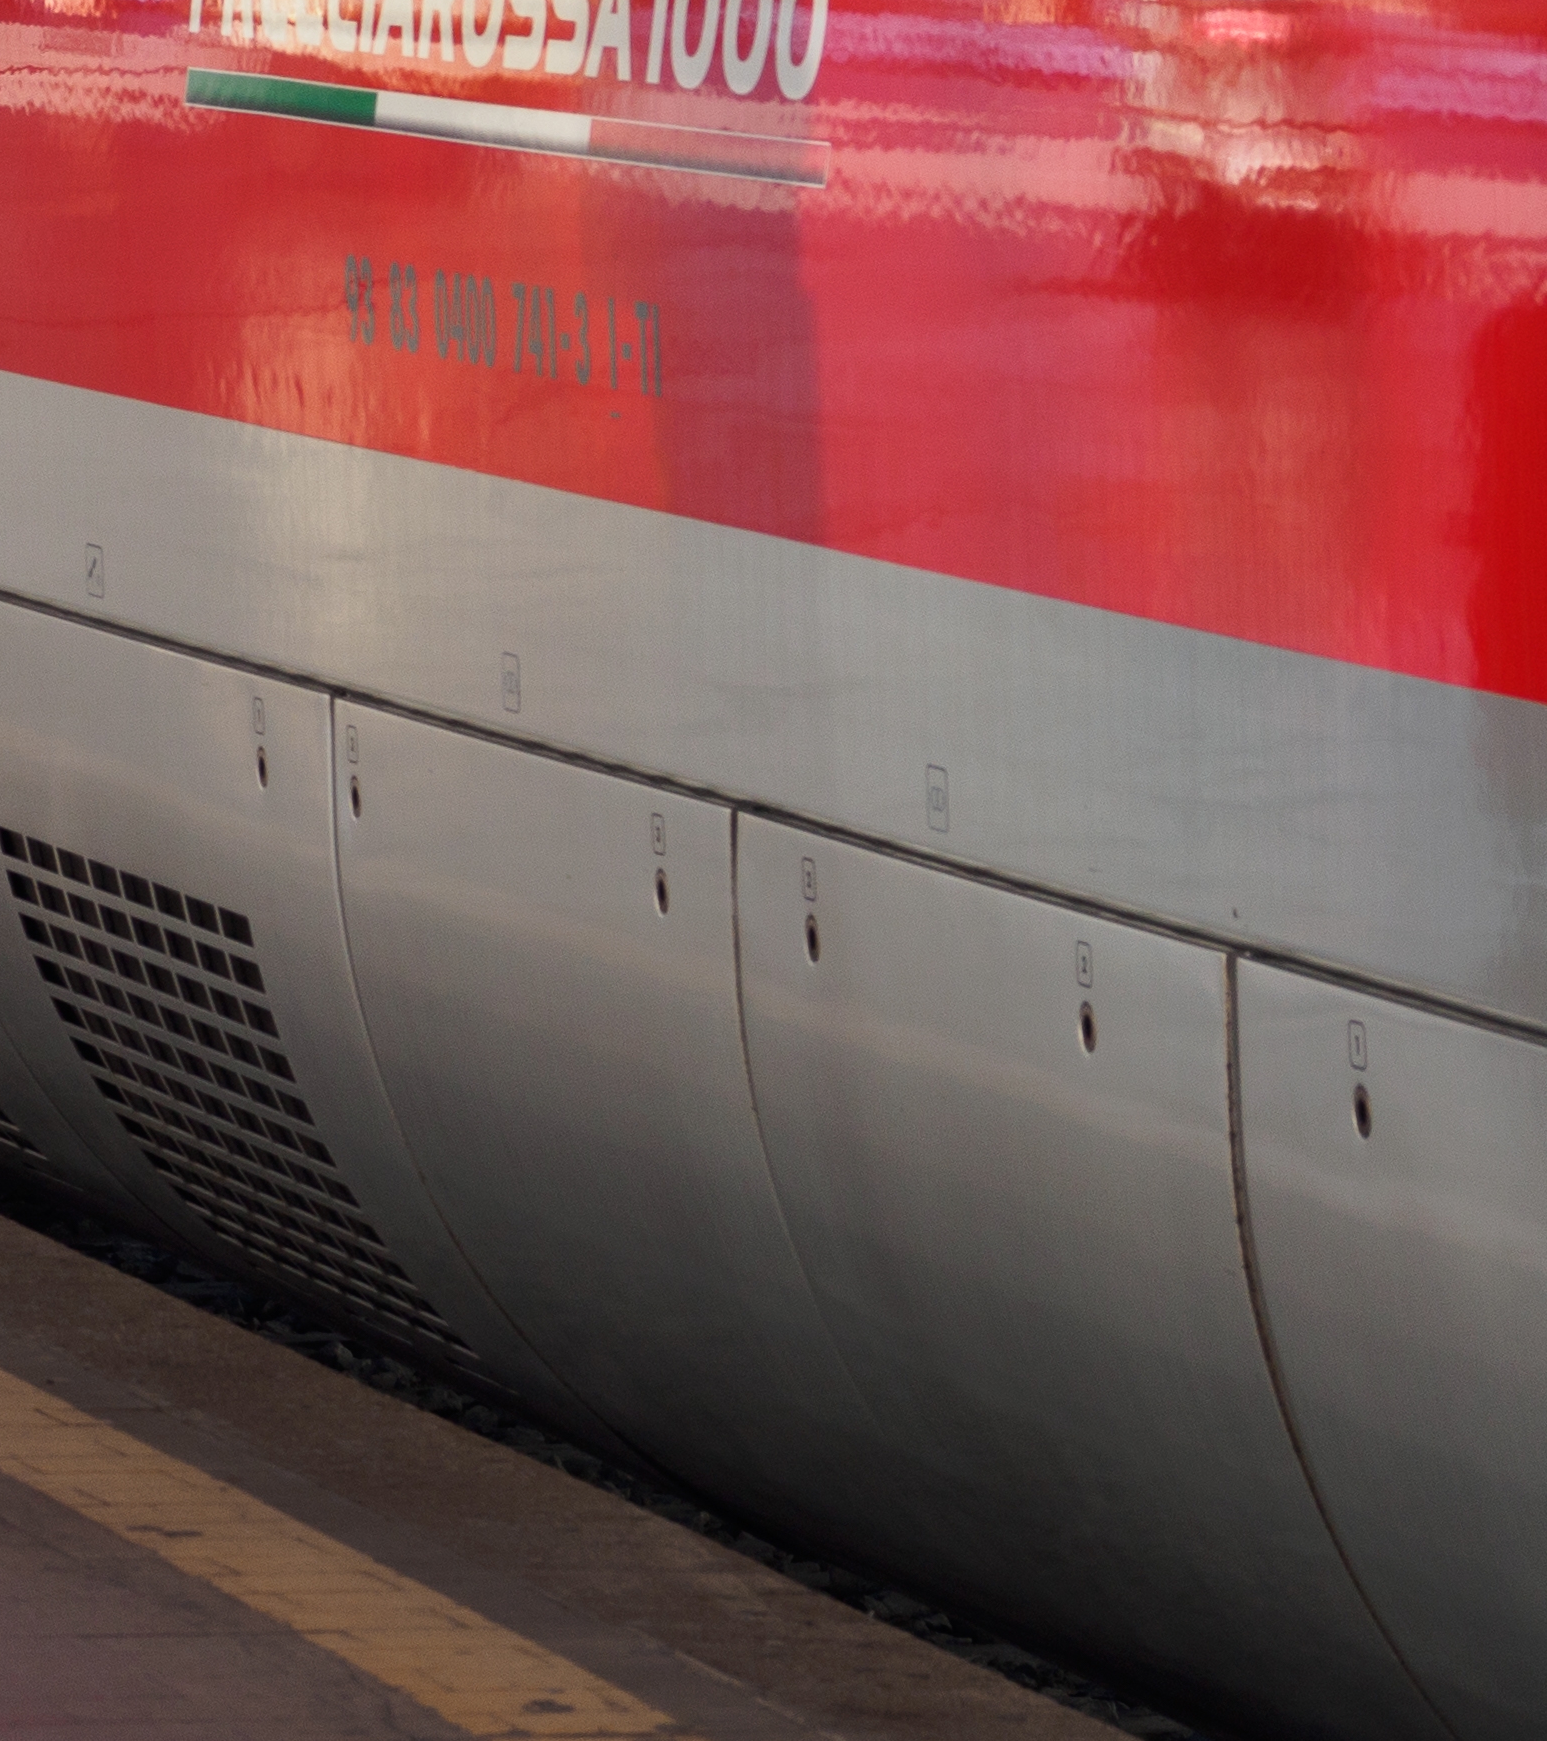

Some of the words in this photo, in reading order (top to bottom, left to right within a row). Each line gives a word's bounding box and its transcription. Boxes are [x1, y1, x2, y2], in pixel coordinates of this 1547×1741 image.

[345, 254, 375, 346] 93
[389, 262, 419, 354] 83
[434, 268, 496, 369] 0400
[512, 282, 590, 386] 741-3
